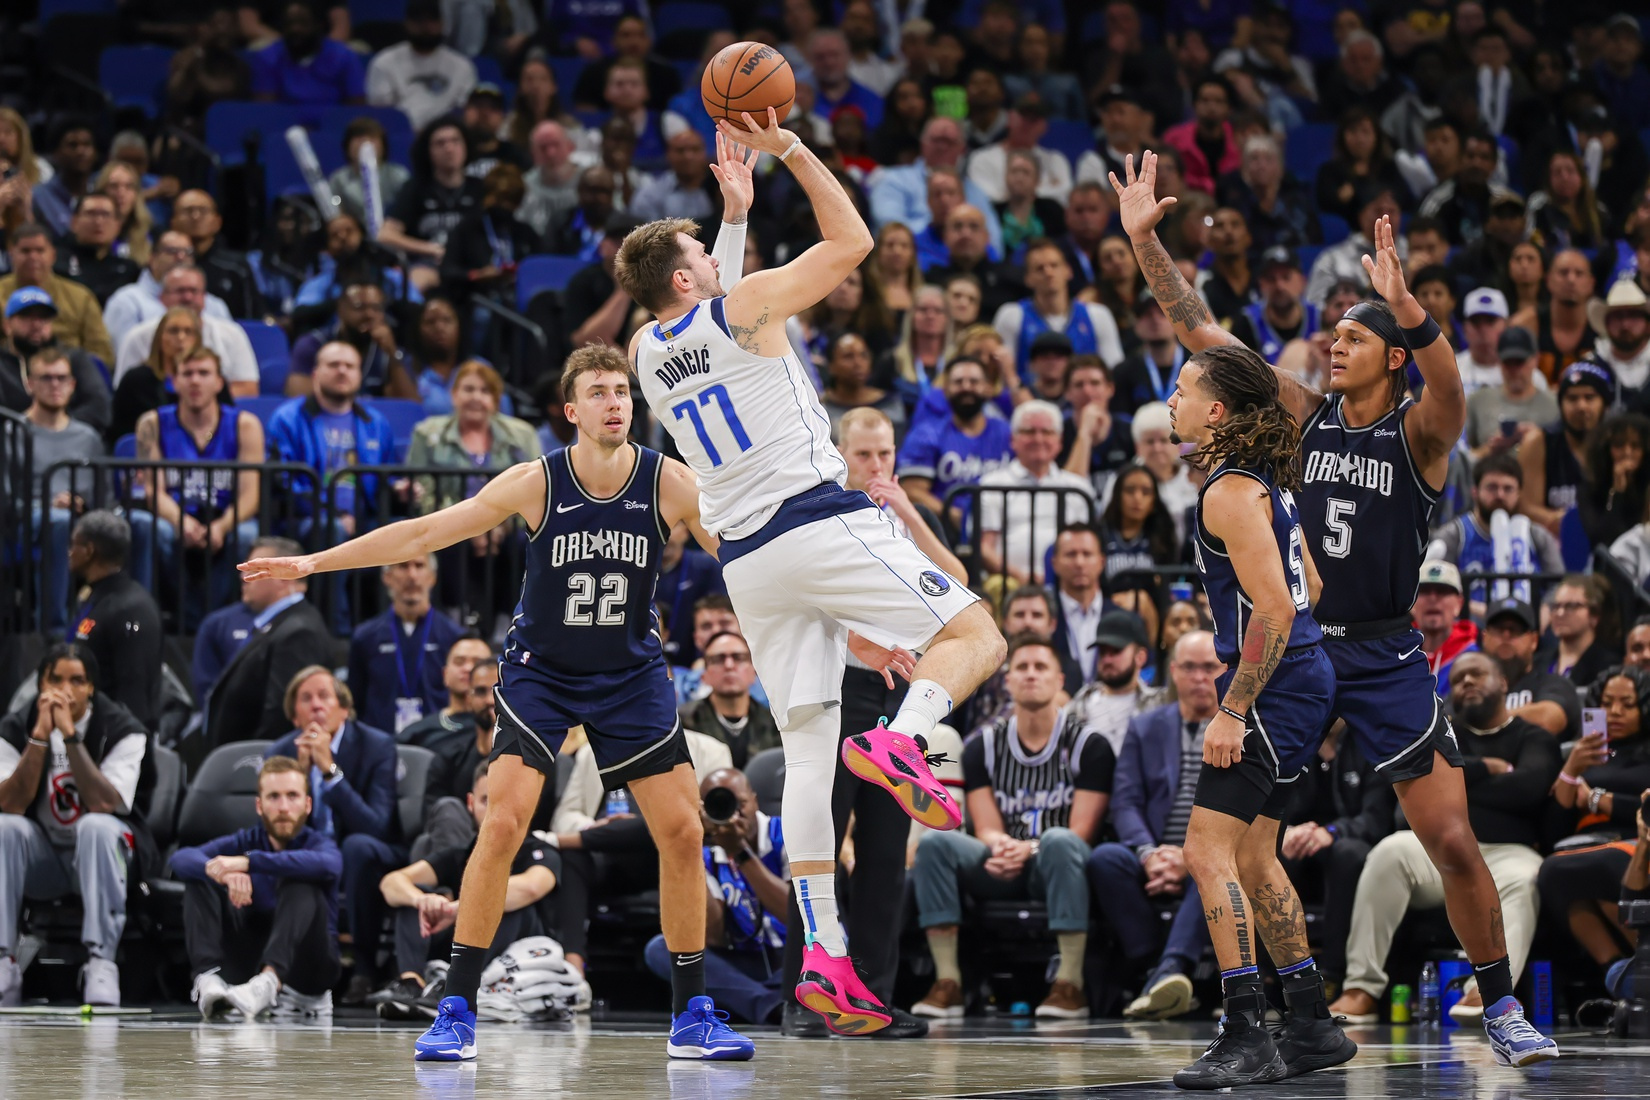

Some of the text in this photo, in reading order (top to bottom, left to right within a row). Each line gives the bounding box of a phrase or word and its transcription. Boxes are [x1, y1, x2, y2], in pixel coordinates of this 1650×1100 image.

[655, 344, 710, 391] DONČIĆ
[671, 384, 753, 469] 77
[1373, 428, 1397, 438] Disney
[623, 499, 649, 511] Disney
[1322, 497, 1356, 559] 5
[563, 572, 628, 626] 22
[1227, 882, 1246, 919] COUNT
